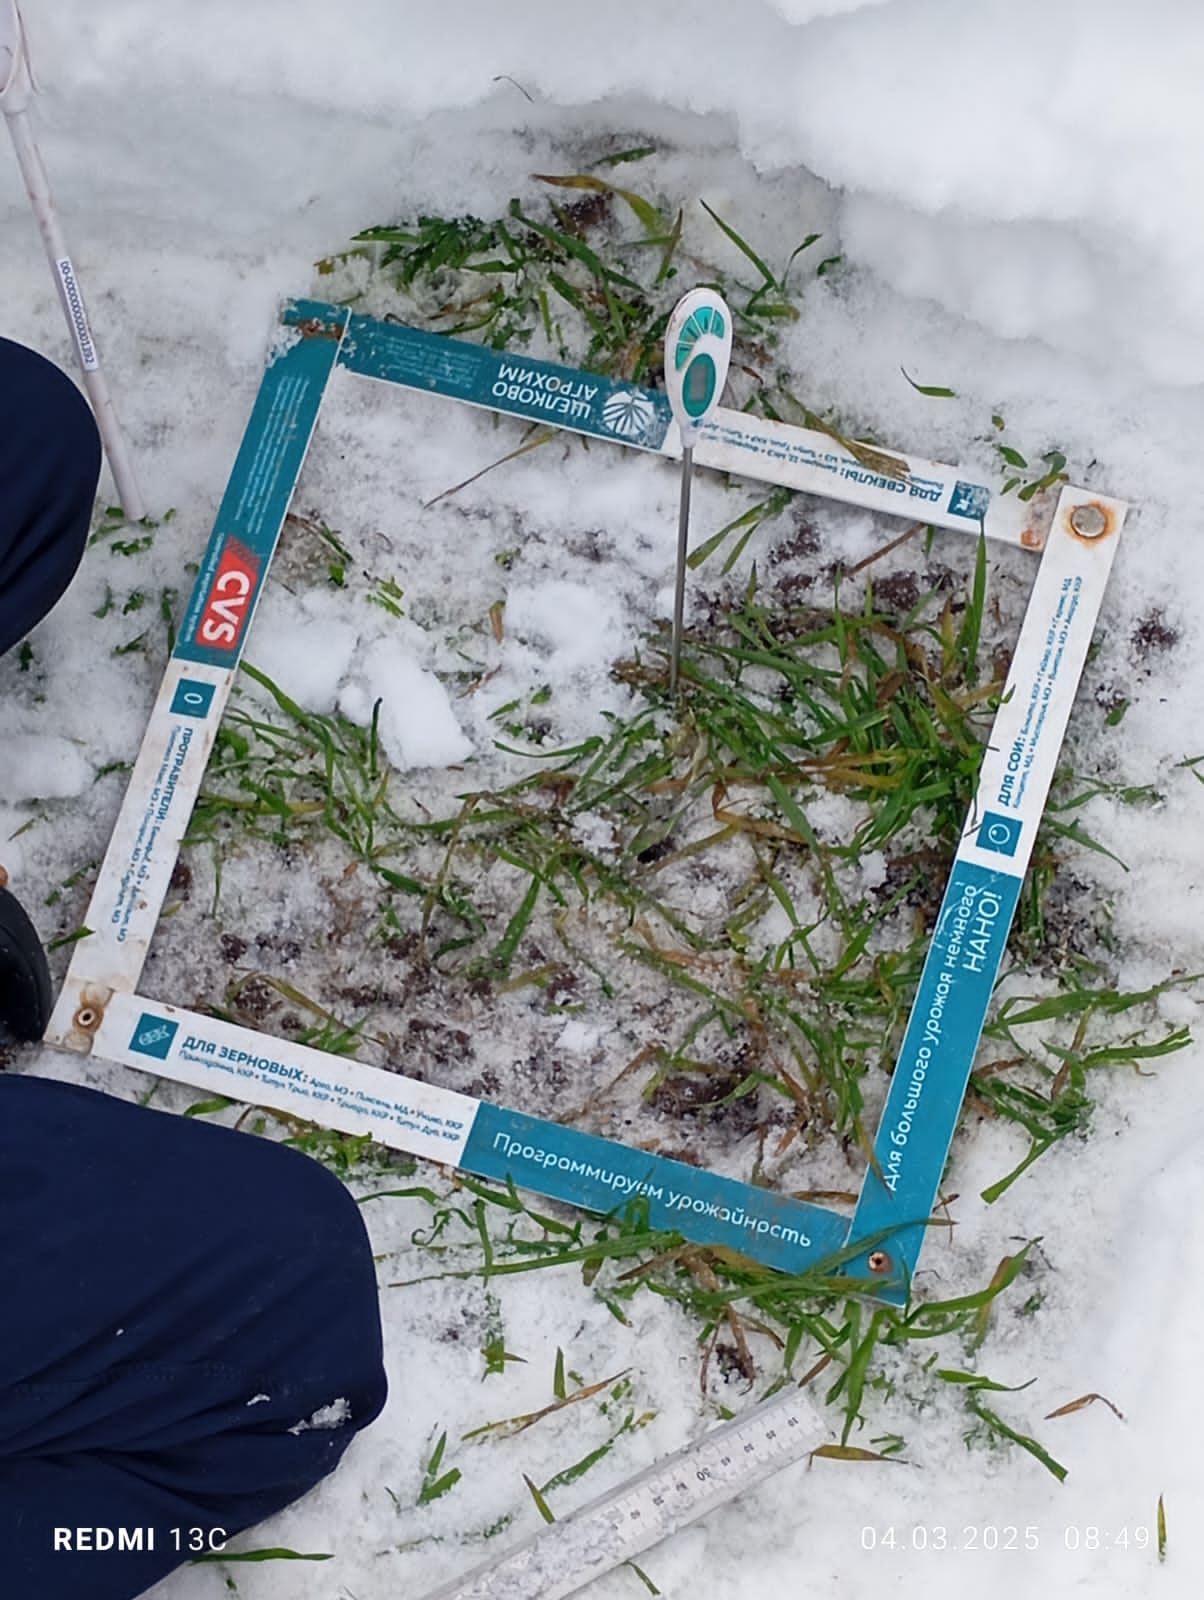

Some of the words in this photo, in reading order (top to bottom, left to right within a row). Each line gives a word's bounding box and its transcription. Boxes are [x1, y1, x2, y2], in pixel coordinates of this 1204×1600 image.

[492, 381, 590, 417] ЩЕЛКОВО
[498, 364, 597, 400] АГРОХИМ
[840, 468, 905, 492] СВЕКЛЫ:
[202, 571, 249, 641] CVS
[155, 727, 192, 823] ПРОТРАВИТЕЛИ:
[998, 774, 1014, 806] ДЛЯ
[1007, 737, 1025, 771] СОИ:
[963, 891, 1001, 971] НАНО!
[890, 1047, 931, 1145] большого
[923, 972, 954, 1044] урожая
[944, 885, 977, 967] немного
[181, 1036, 216, 1054] ДЛЯ
[219, 1046, 307, 1081] ЗЕРНОВЫХ:
[493, 1133, 662, 1198] Программируем
[665, 1192, 810, 1246] урожайность
